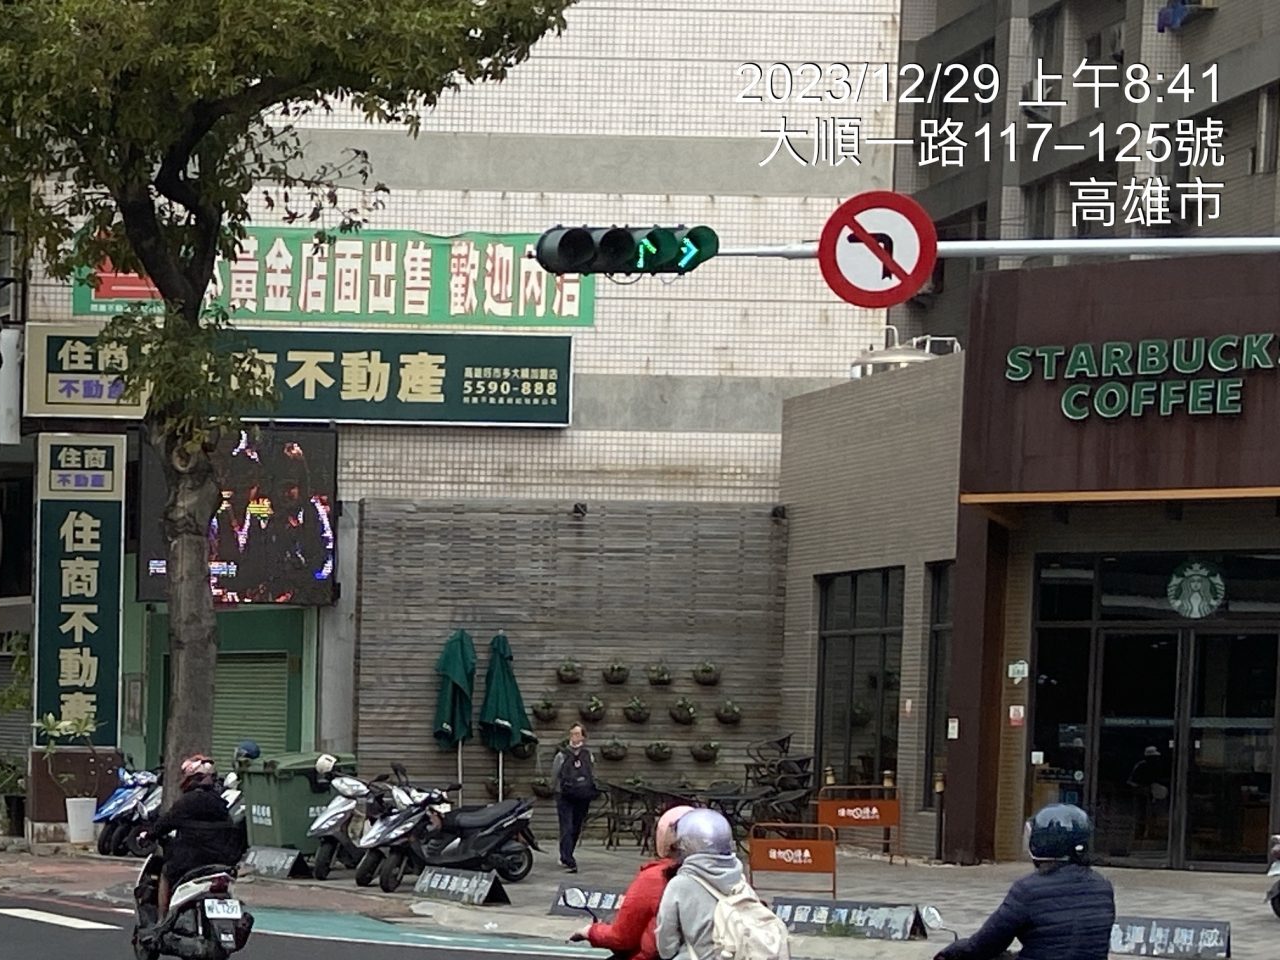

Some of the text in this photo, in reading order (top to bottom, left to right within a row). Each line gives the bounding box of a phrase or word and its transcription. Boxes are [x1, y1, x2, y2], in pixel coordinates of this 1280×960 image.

[1005, 333, 1280, 381] STARBUCK
[463, 380, 557, 396] 5590-888
[1061, 378, 1243, 420] COFFEE
[57, 446, 107, 469] 住商
[56, 473, 106, 488] 不動產
[58, 510, 102, 738] 住商不動產
